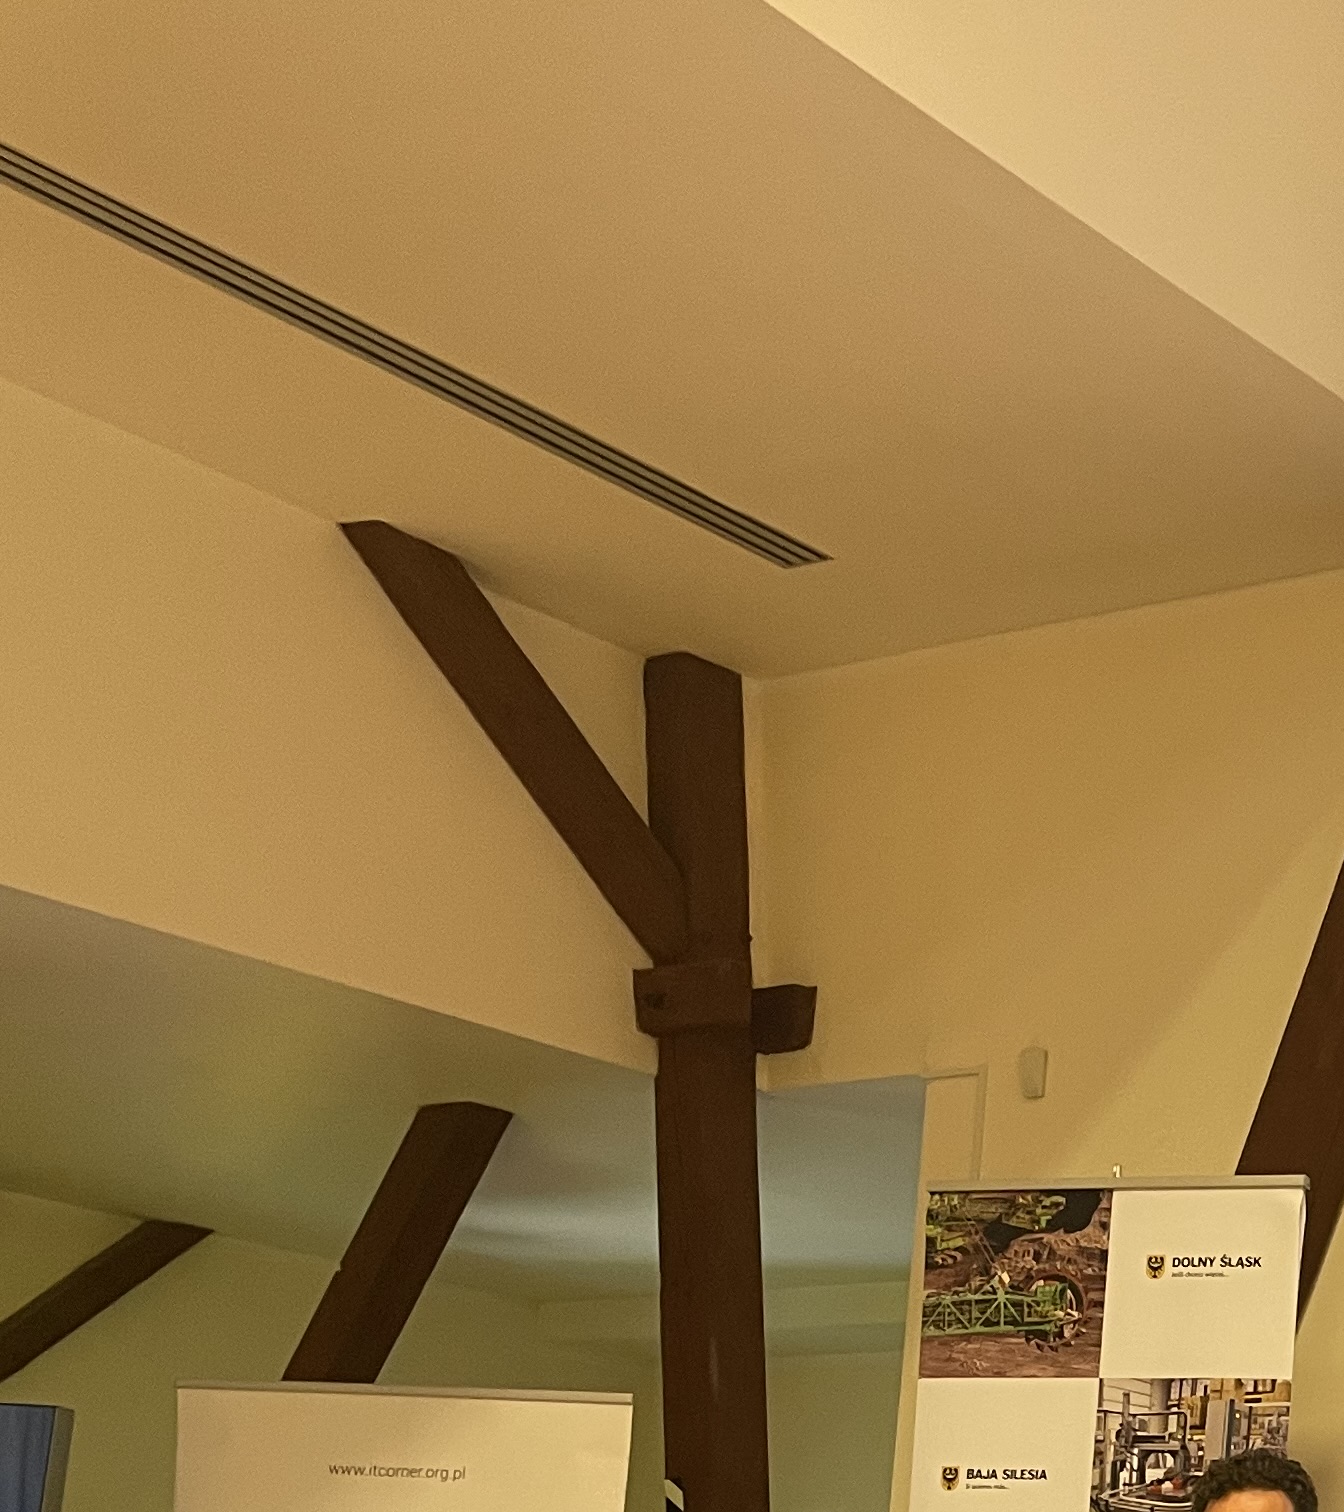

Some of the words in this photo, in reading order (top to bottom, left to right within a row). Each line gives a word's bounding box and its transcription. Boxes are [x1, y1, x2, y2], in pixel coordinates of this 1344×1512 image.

[1172, 1256, 1216, 1267] DOLNY
[1219, 1254, 1262, 1269] ŚLĄSK
[328, 1463, 466, 1482] www.itcorner.org.pl
[966, 1468, 998, 1479] BAJA
[1002, 1469, 1047, 1480] SILESIA
